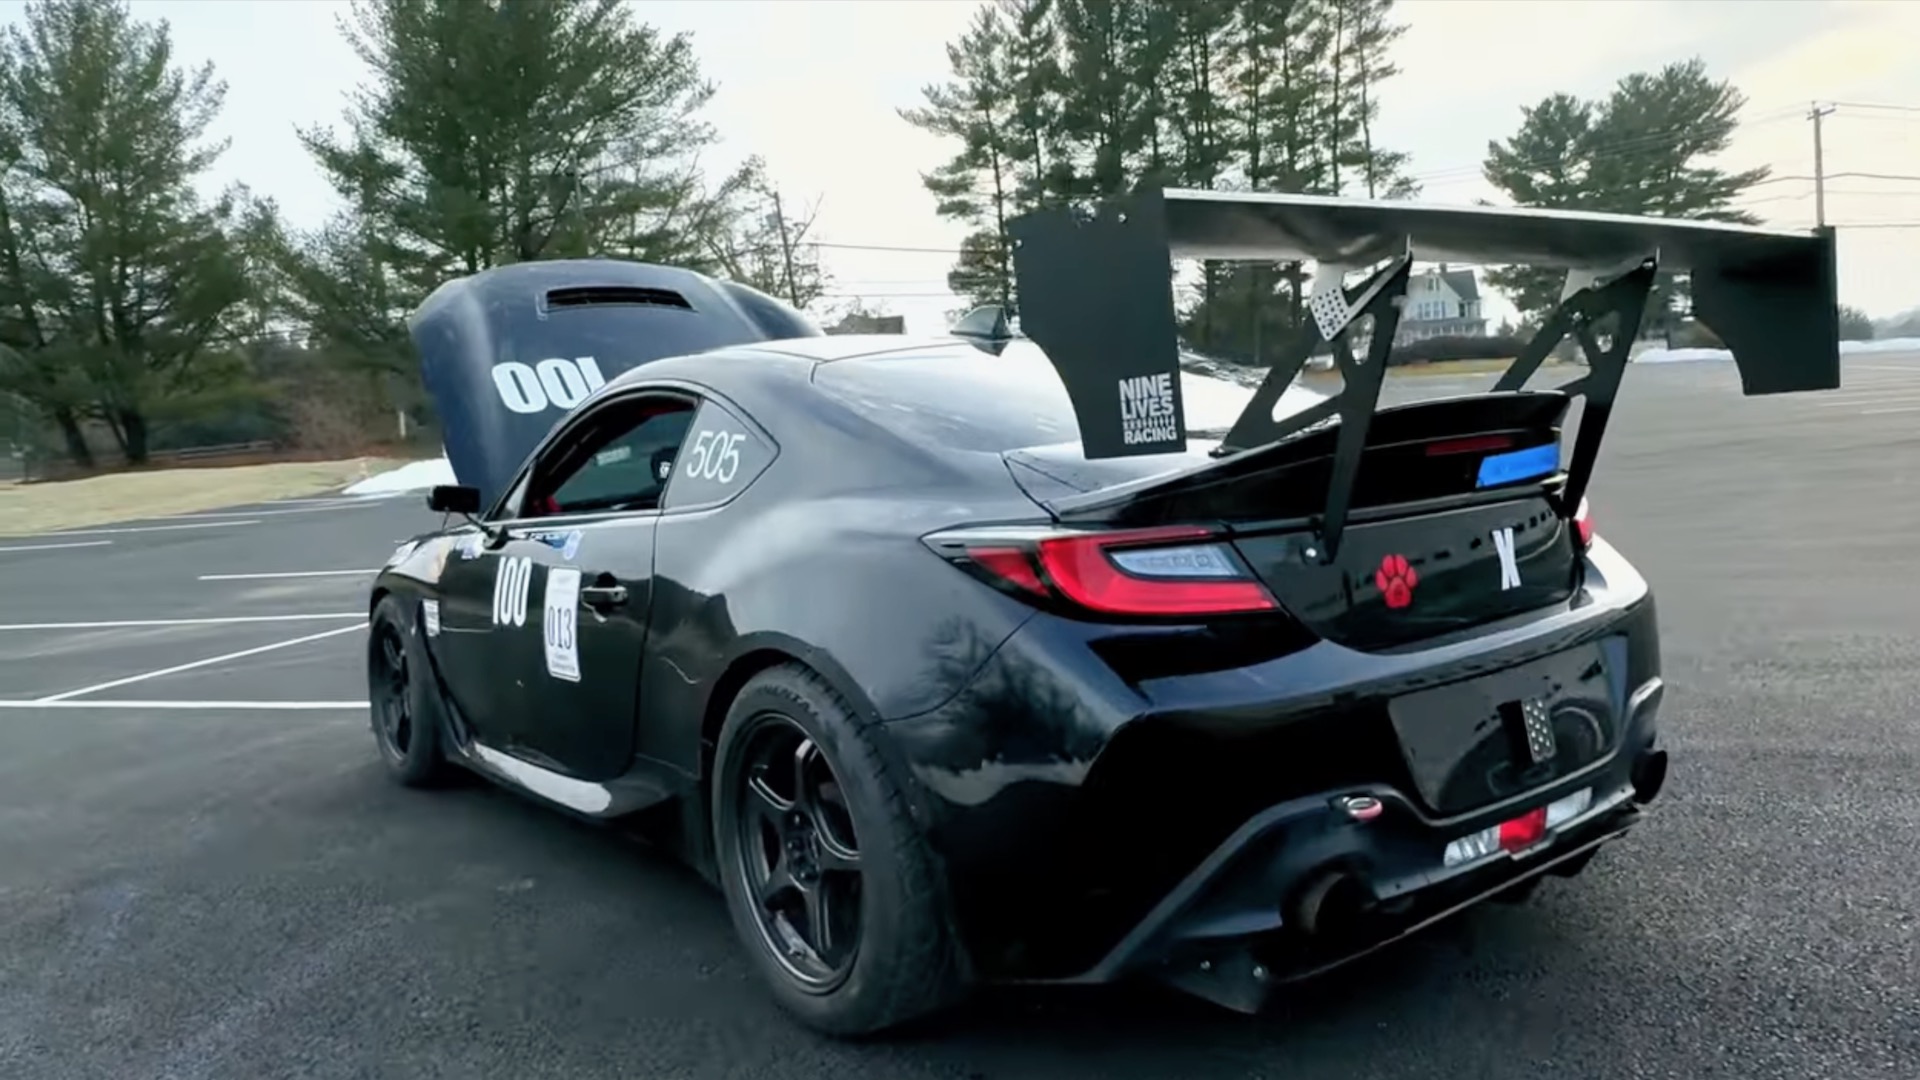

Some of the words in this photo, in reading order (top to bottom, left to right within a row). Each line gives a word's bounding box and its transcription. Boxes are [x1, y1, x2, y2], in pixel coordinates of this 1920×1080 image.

[1118, 372, 1173, 401] NINE
[1121, 396, 1175, 420] LIVES
[1124, 426, 1177, 444] RACING
[686, 430, 746, 484] 505
[493, 556, 532, 627] 100
[548, 606, 572, 649] 013
